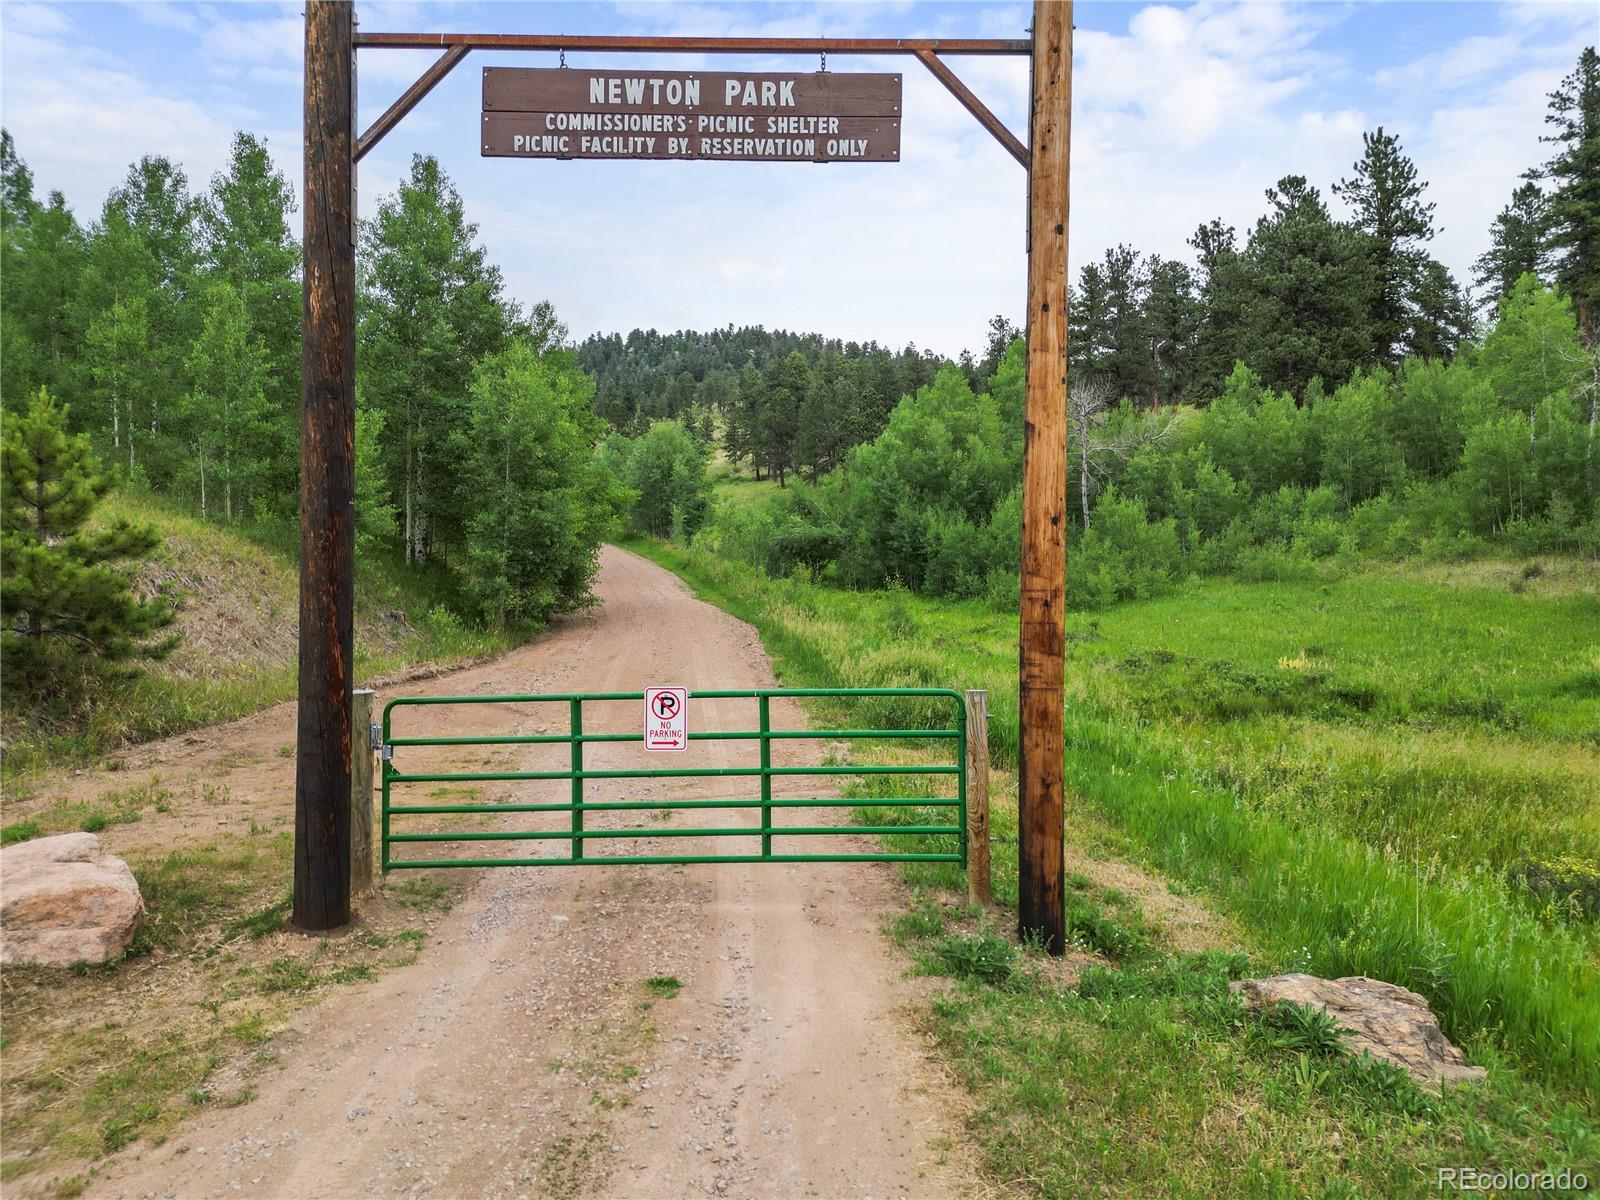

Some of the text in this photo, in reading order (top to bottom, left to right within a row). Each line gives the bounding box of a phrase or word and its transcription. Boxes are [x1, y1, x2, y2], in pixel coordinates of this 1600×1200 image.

[589, 77, 796, 107] NEWTON PARK
[545, 113, 839, 134] COMMISSIONER'S PICNIC SHELTER
[513, 135, 569, 152] PICNIC
[581, 136, 656, 154] FACILITY
[701, 138, 815, 156] RESERVATION
[827, 139, 868, 156] ONLY
[650, 730, 682, 738] PARKING
[660, 721, 671, 729] NO
